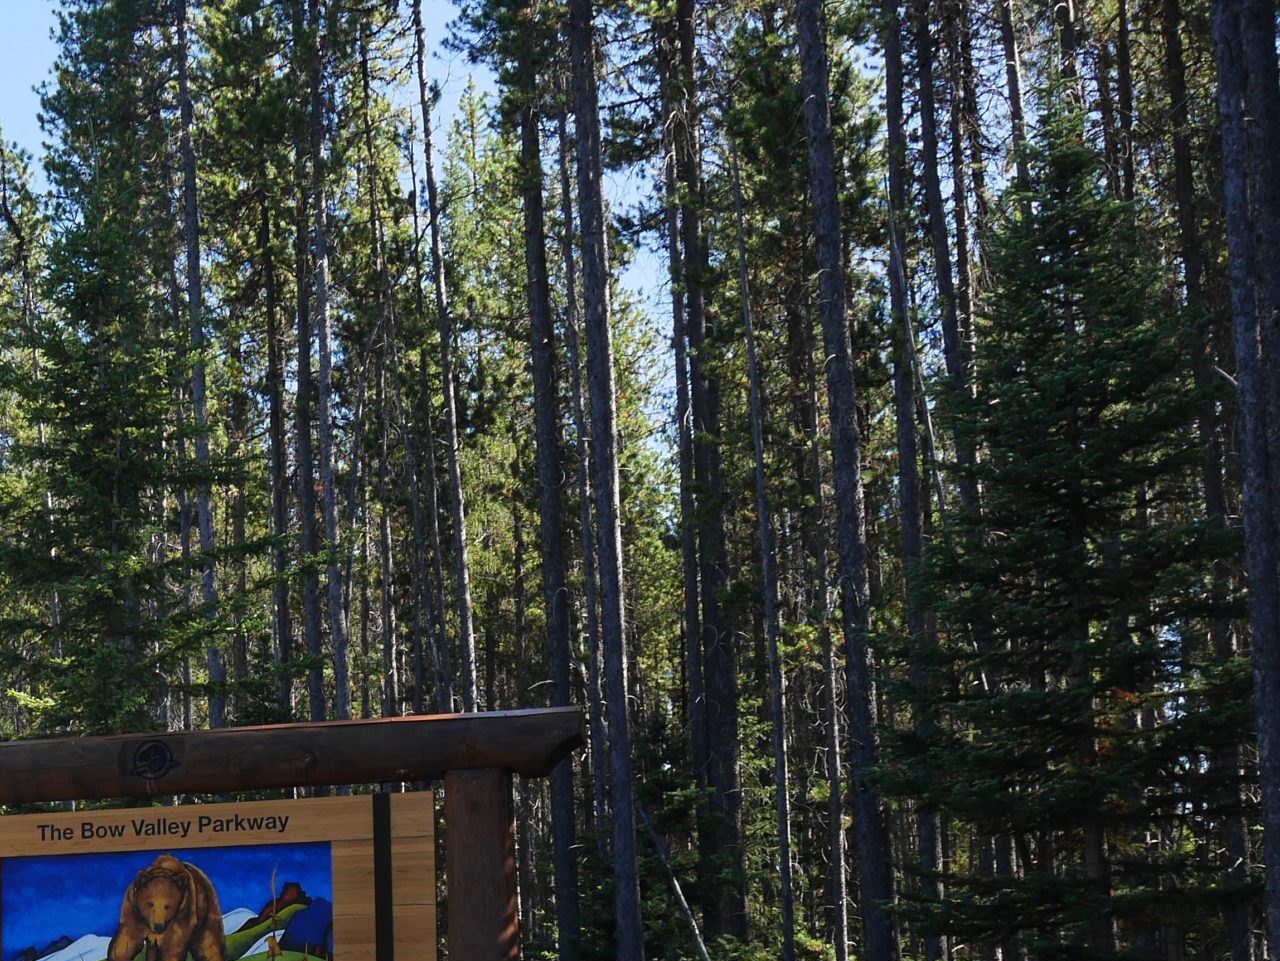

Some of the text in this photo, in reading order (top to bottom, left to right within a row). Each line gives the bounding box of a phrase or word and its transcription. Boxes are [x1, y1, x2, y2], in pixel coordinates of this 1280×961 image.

[37, 814, 290, 841] The Bow Valley Parkway
